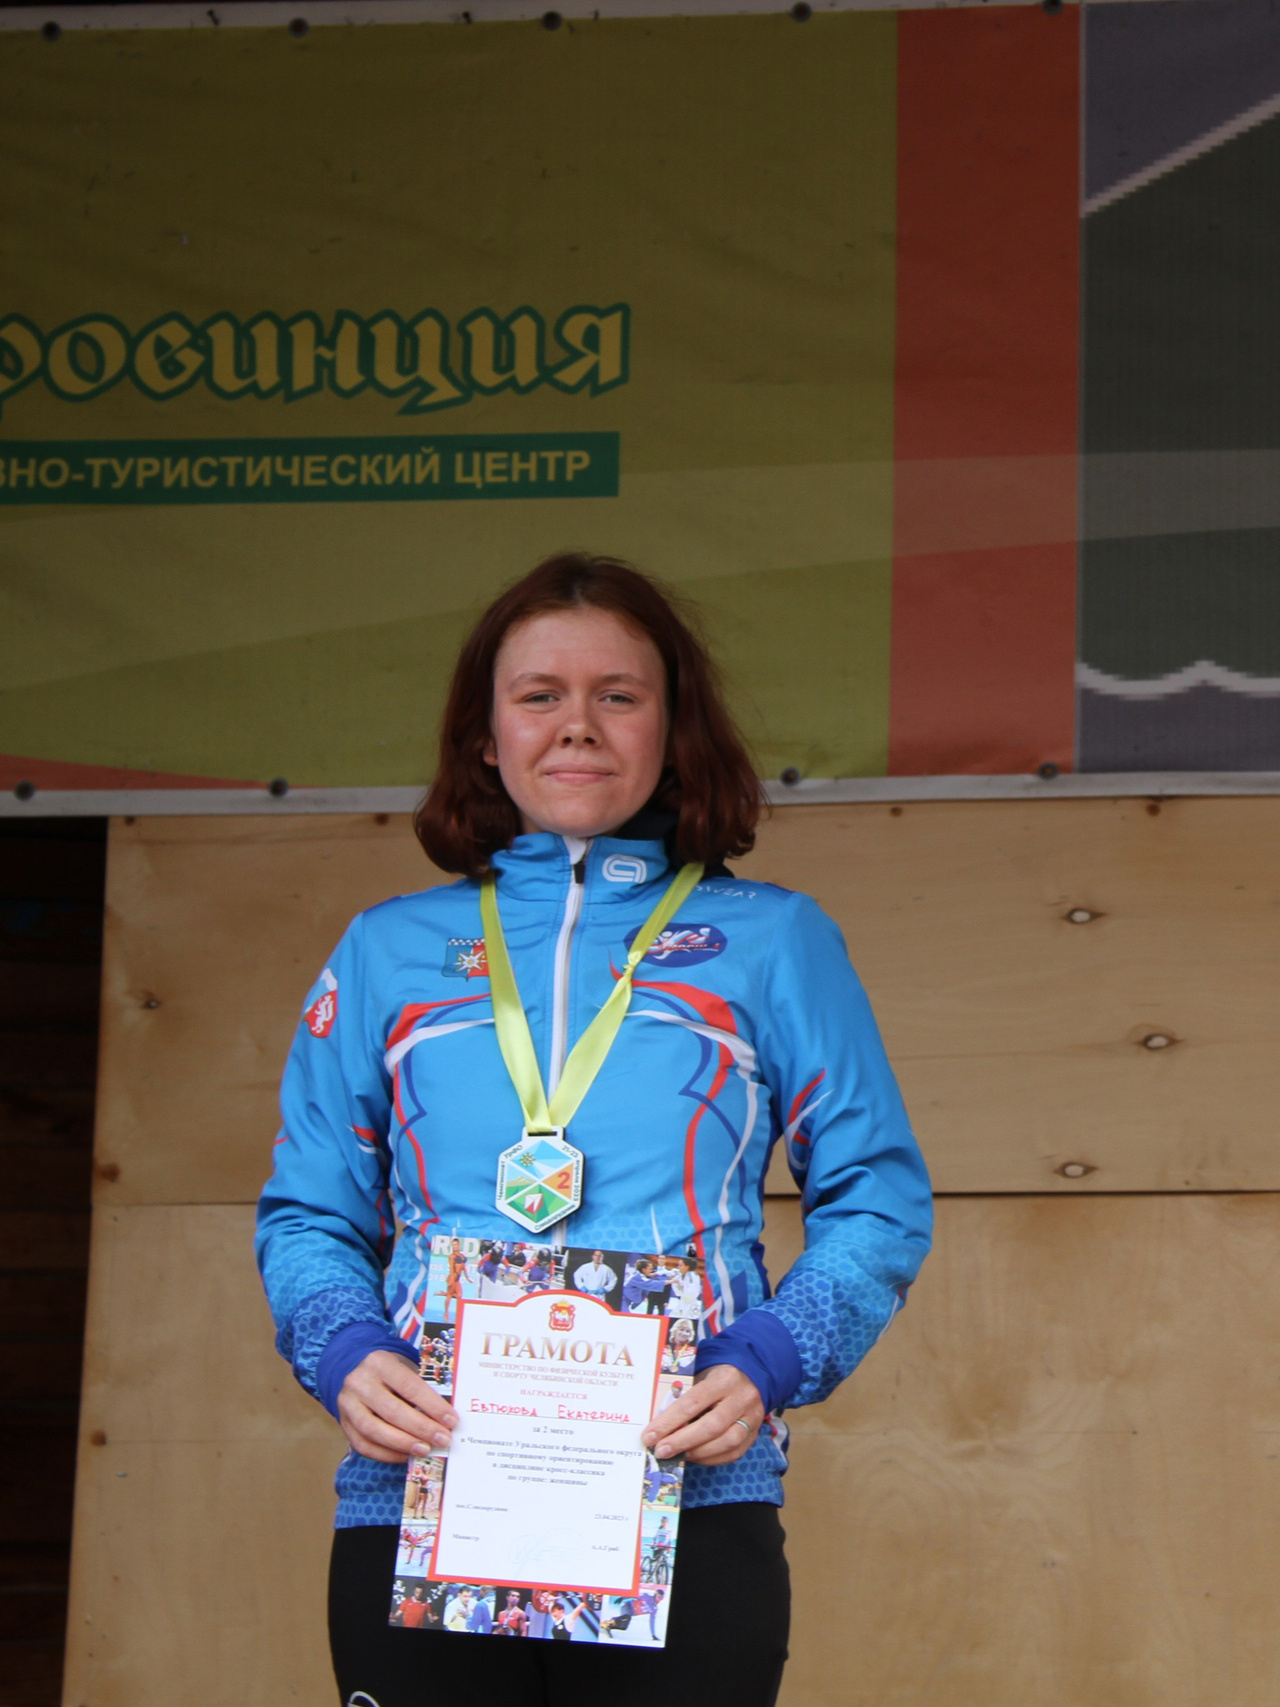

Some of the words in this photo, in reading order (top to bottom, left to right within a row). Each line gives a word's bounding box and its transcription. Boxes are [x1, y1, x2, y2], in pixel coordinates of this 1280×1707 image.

[0, 446, 440, 490] НО-ТУРИСТИЧЕСКИЙ
[455, 449, 591, 490] ЦЕНТР
[557, 1171, 570, 1190] 2
[481, 1332, 635, 1367] ГРАМОТА
[478, 1361, 537, 1372] МИНИСТЕРСТВО
[520, 1388, 588, 1400] НАГРАЖДАЕТСЯ
[543, 1426, 548, 1434] 2
[550, 1428, 574, 1436] место
